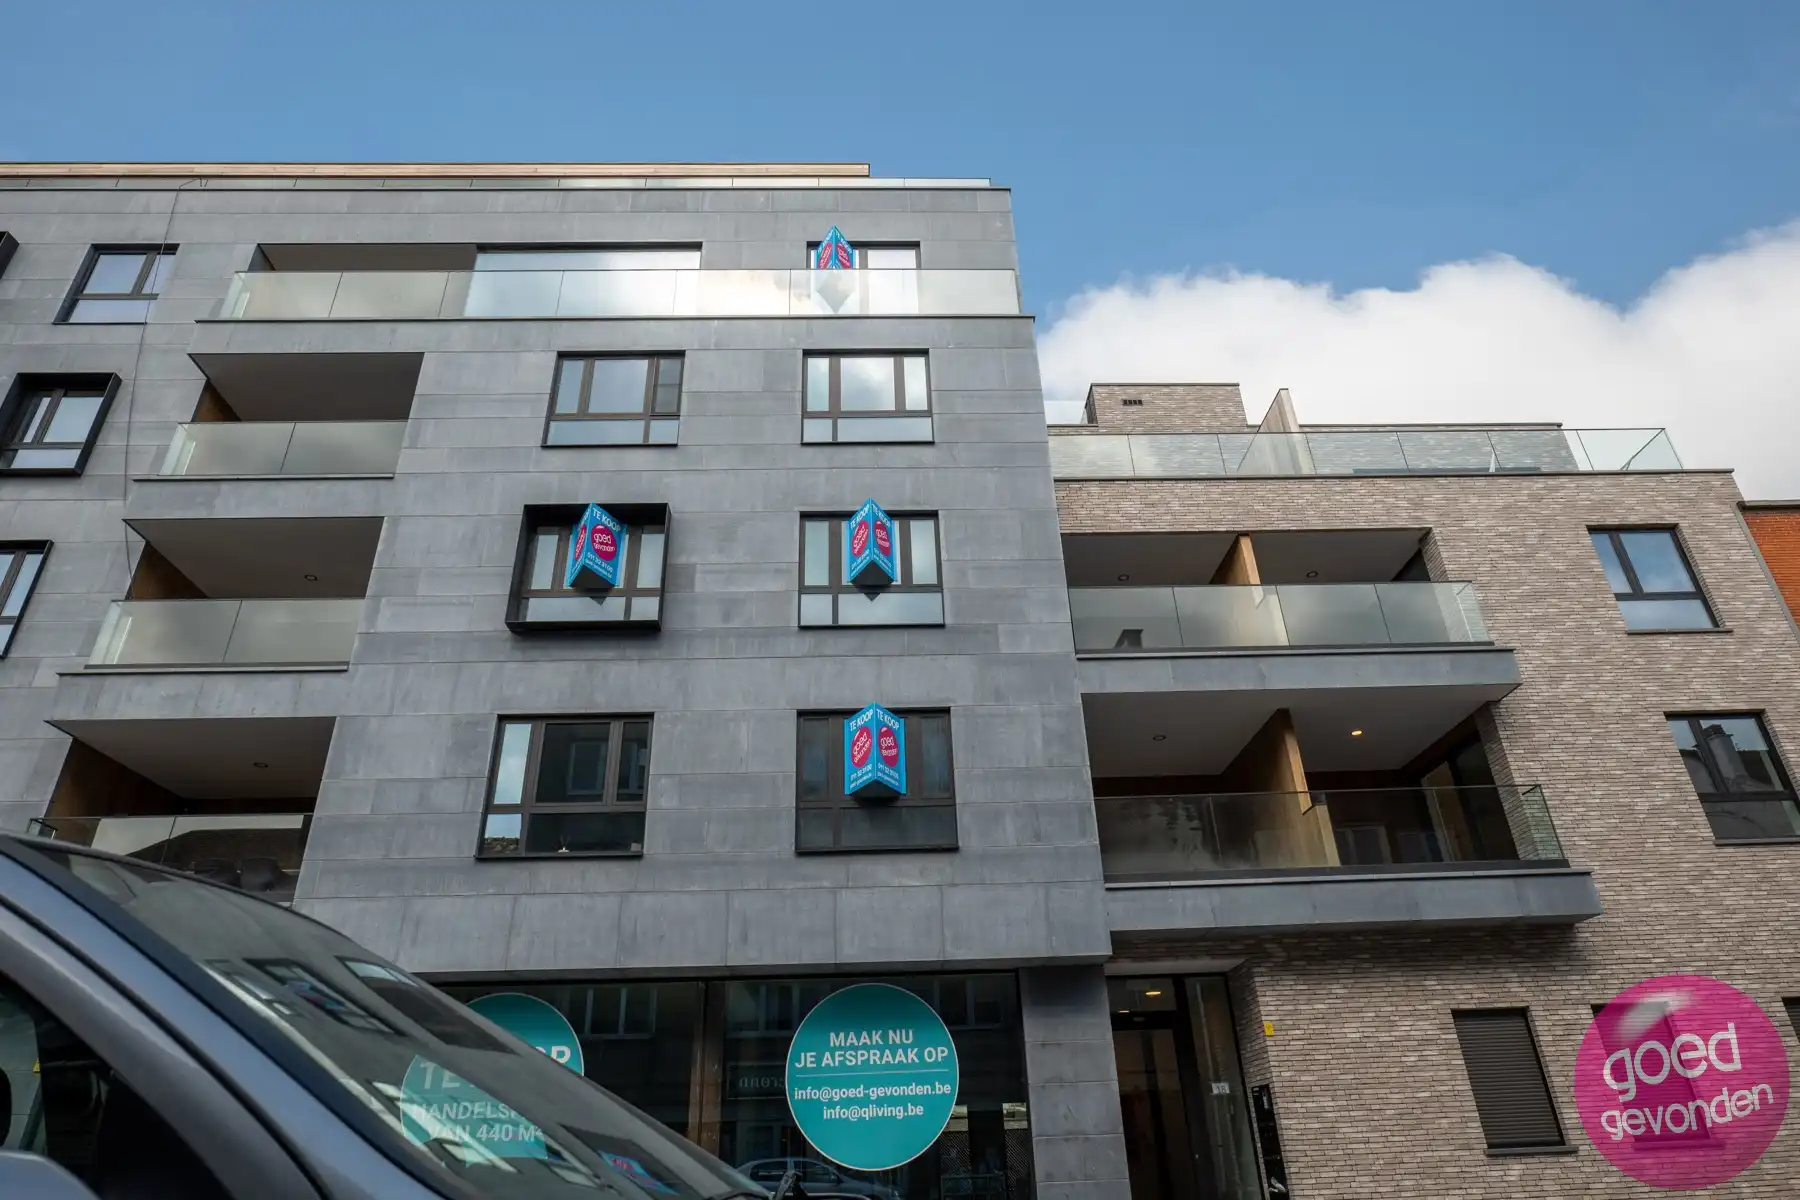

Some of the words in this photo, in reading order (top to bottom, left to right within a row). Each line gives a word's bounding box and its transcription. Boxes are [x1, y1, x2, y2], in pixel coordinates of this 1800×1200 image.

[592, 508, 601, 520] TE
[602, 513, 621, 532] KOOP
[849, 720, 856, 731] TE
[856, 709, 874, 727] KOOP
[876, 709, 884, 721] TE
[829, 1029, 884, 1047] MAAK
[888, 1028, 913, 1044] NU
[795, 1052, 817, 1068] JE
[821, 1048, 920, 1067] AFSPRAAK
[924, 1046, 949, 1062] OP
[794, 1081, 952, 1102] info@goed-gevonden.be
[823, 1103, 924, 1122] info@qliving.be
[475, 1124, 513, 1141] 440
